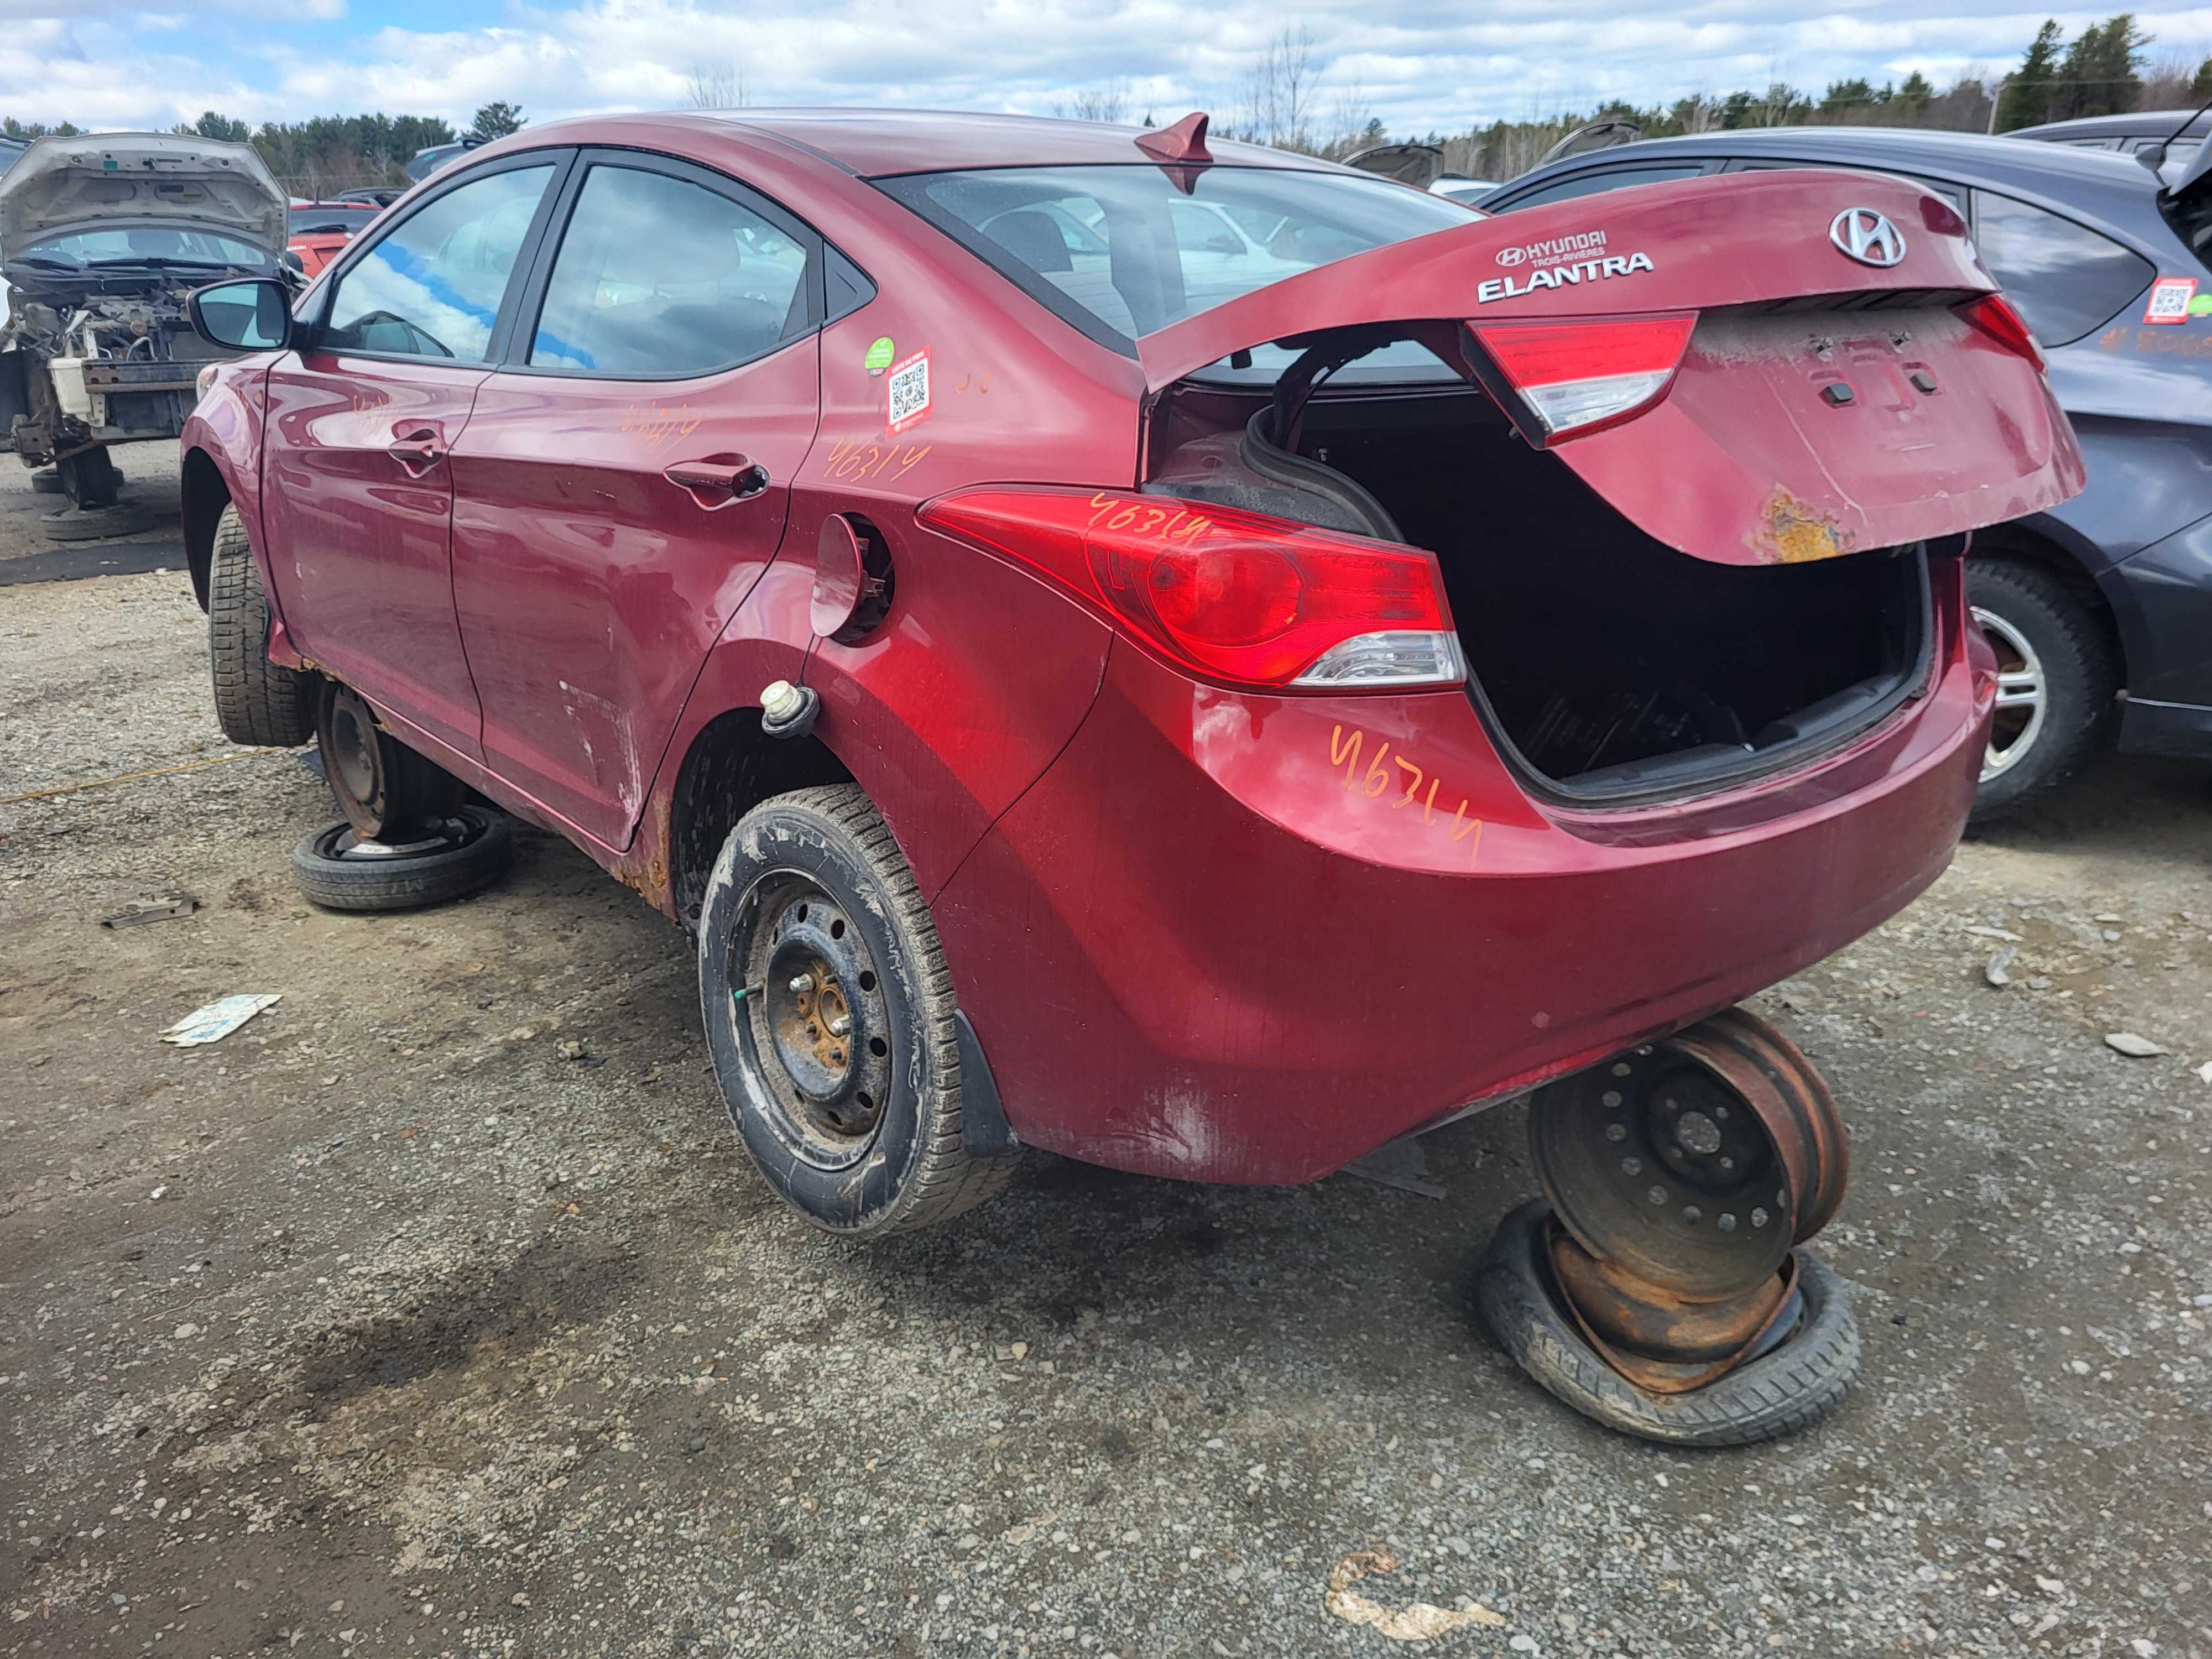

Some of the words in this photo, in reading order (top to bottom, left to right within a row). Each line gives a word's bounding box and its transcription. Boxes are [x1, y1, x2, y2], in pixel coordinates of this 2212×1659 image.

[1526, 230, 1608, 259] HYUNDAI
[1477, 252, 1655, 304] ELANTRA
[823, 437, 932, 483] 46314
[1330, 724, 1483, 871] 46314
